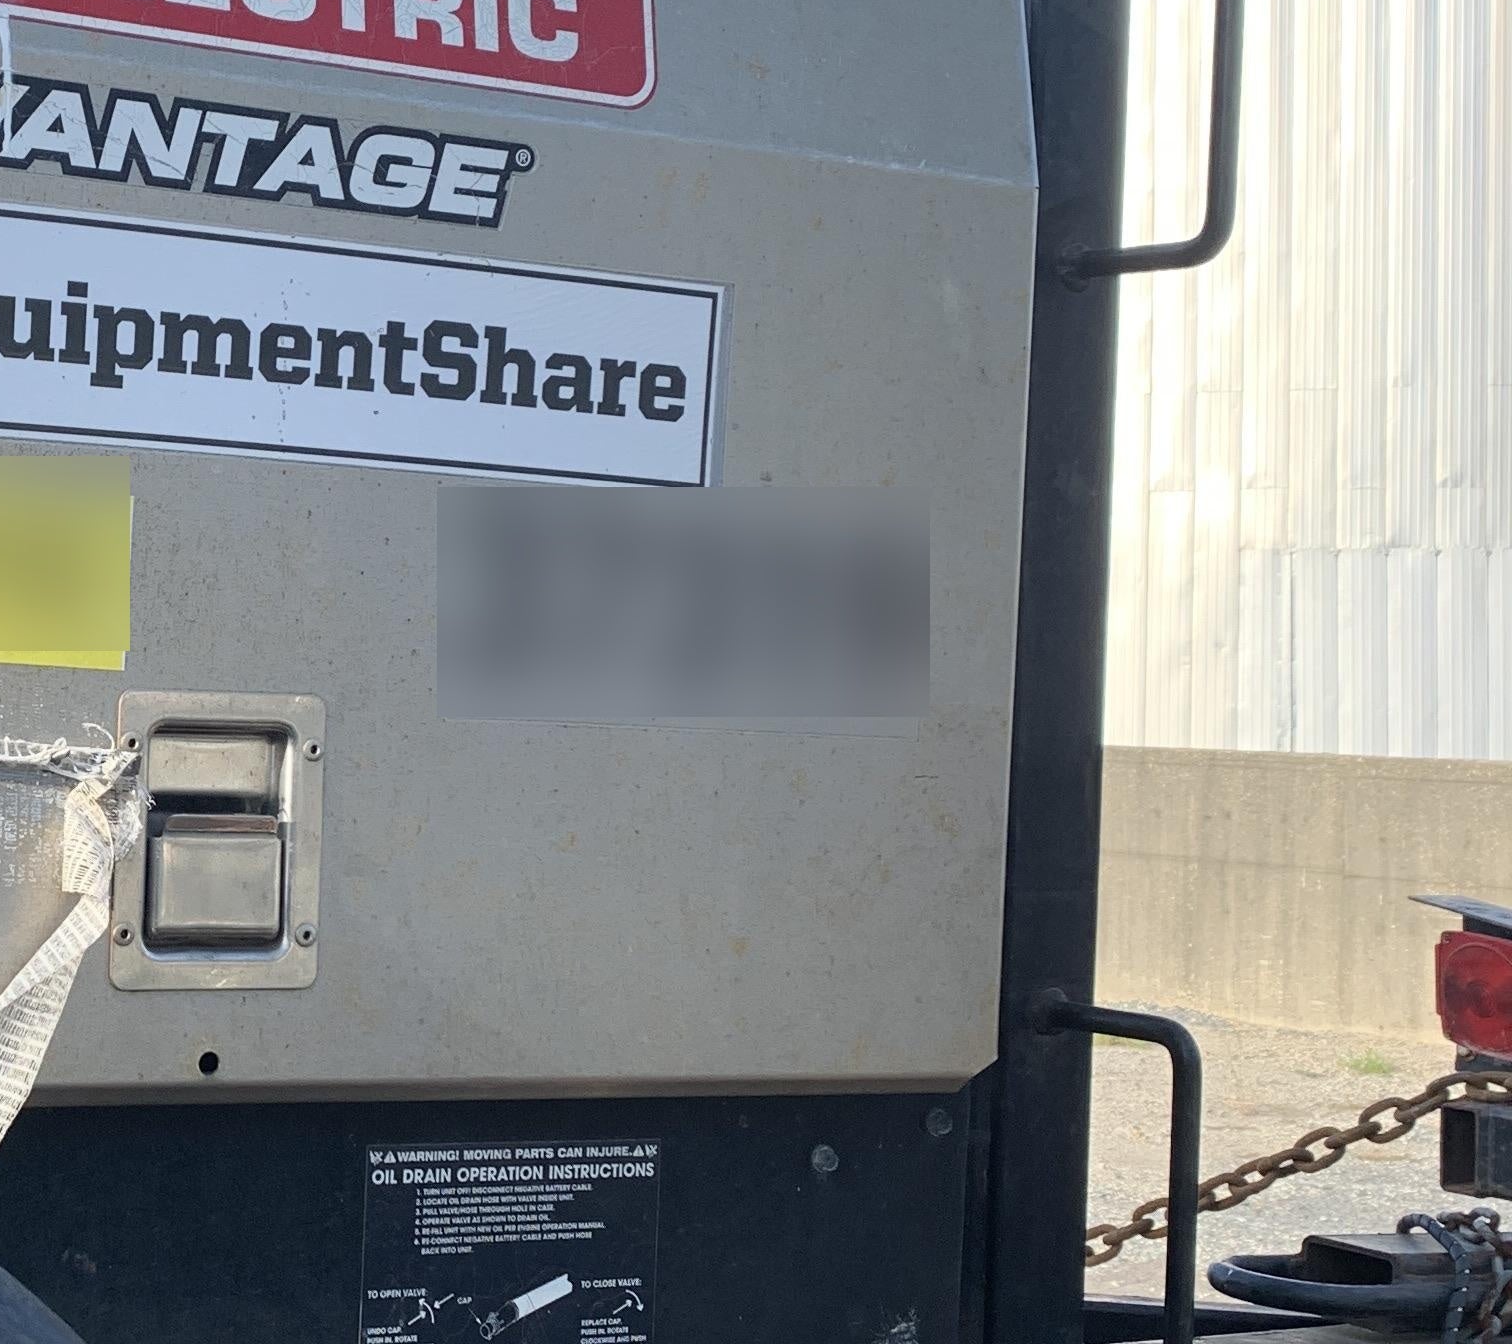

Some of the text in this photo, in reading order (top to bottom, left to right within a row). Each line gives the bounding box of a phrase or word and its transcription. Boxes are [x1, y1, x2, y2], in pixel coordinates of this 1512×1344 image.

[397, 1146, 633, 1162] WARNING! MOVING PARTS CAN INJURE.
[371, 1162, 655, 1185] OIL DRAIN OPERATION INSTRUCTIONS
[472, 1186, 514, 1194] DISCONNECT
[514, 1185, 545, 1193] NEGATIVE
[545, 1184, 570, 1192] BATTERY
[482, 1196, 499, 1204] HOSE
[479, 1206, 510, 1214] THROUGH
[422, 1217, 450, 1225] OPERATE
[481, 1215, 506, 1223] SHOWN
[517, 1214, 537, 1222] DRAIN
[477, 1225, 491, 1233] NEW
[504, 1224, 517, 1232] PER
[542, 1222, 577, 1230] OPERATION
[495, 1234, 521, 1242] BATTERY
[543, 1232, 557, 1240] AND
[575, 1231, 592, 1239] HOSE
[421, 1247, 439, 1255] BACK
[441, 1246, 456, 1254] INTO
[581, 1280, 591, 1289] TO
[592, 1279, 616, 1288] CLOSE
[368, 1290, 379, 1299] TO
[379, 1289, 402, 1299] OPEN
[457, 1296, 472, 1304] CAP
[581, 1318, 607, 1326] REPLACE
[366, 1327, 386, 1335] UNDO
[367, 1336, 384, 1344] PUSH
[580, 1336, 616, 1344] CLOCKWISE
